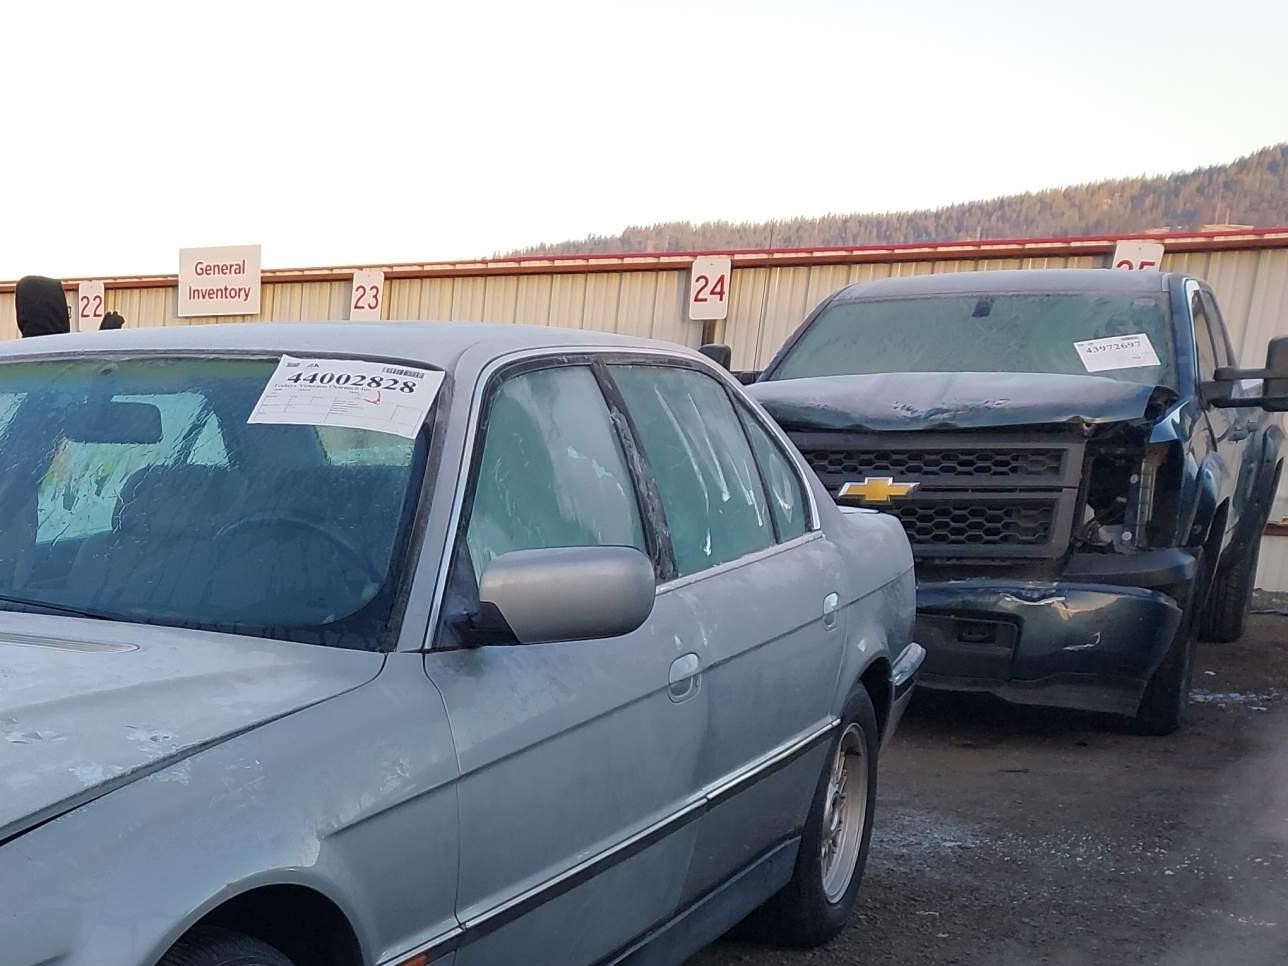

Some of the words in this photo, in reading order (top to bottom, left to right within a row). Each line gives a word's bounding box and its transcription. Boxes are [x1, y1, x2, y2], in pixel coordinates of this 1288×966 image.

[194, 259, 246, 276] General
[188, 284, 251, 302] Inventory
[353, 285, 380, 310] 23
[693, 274, 726, 303] 24
[80, 295, 103, 318] 22
[1085, 341, 1141, 354] 43972697
[287, 372, 417, 394] 44002828
